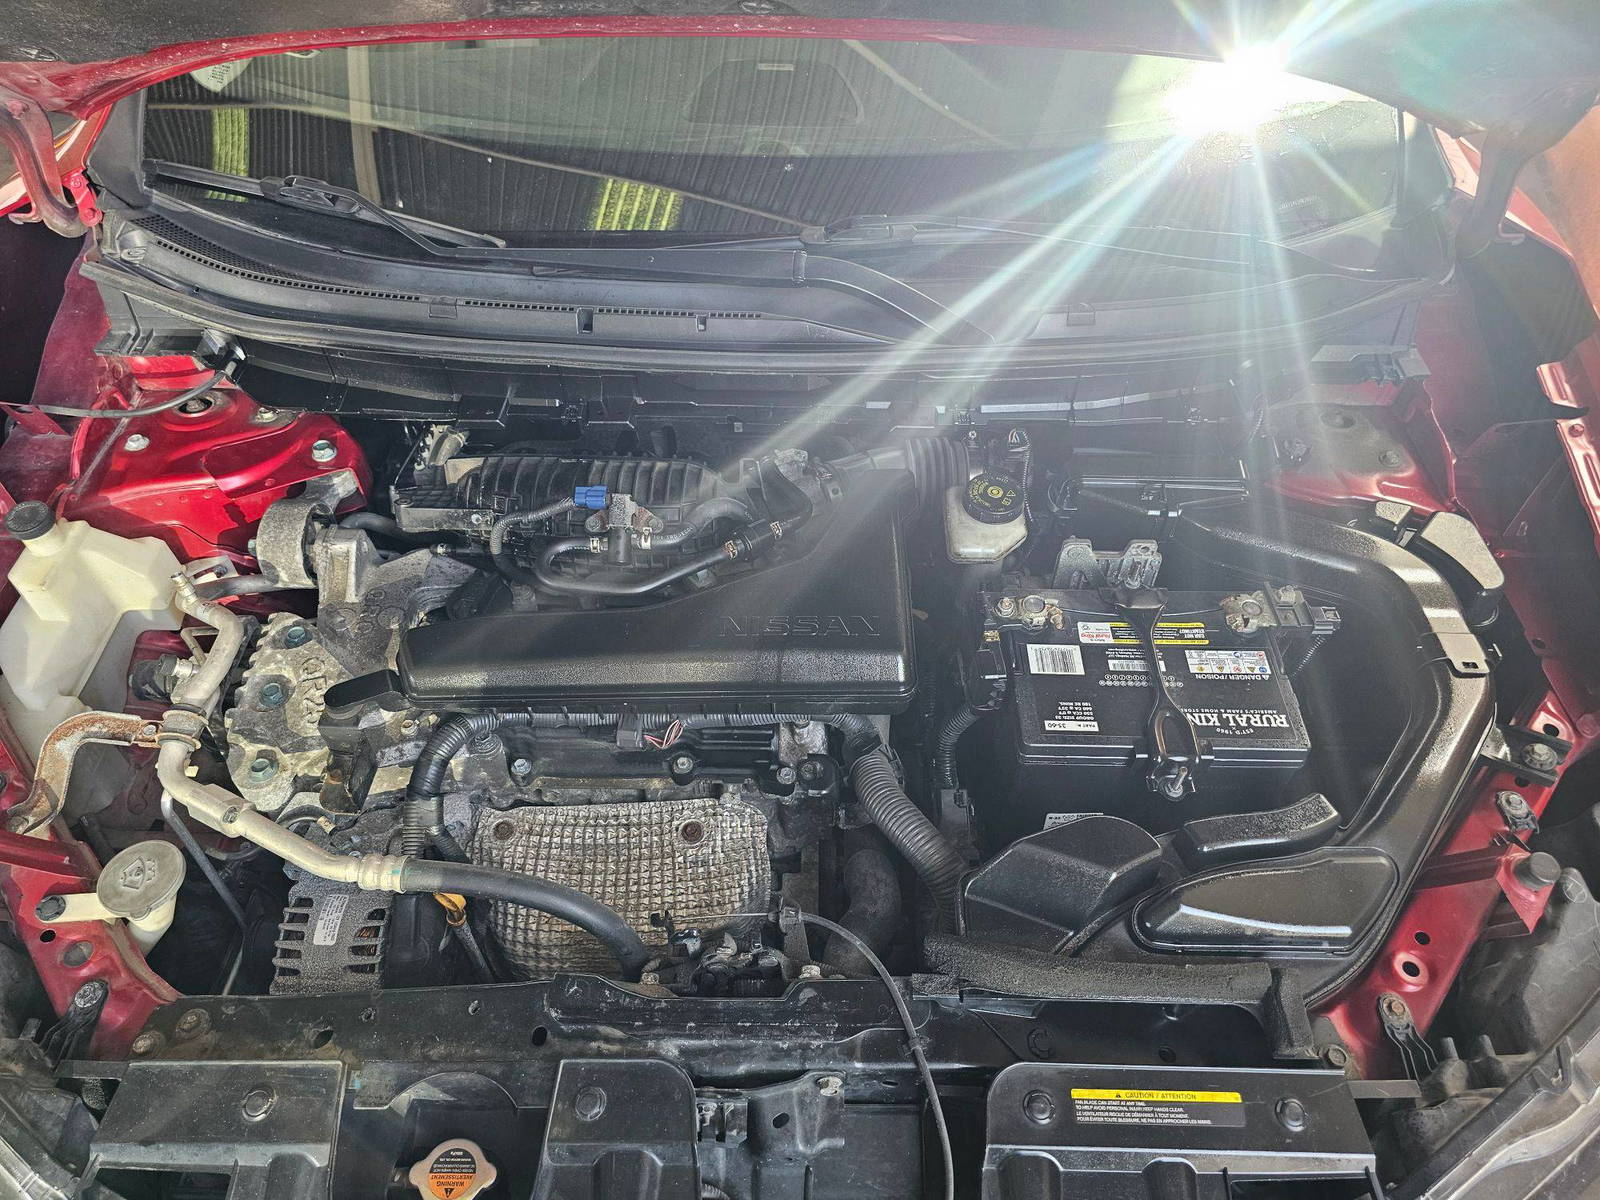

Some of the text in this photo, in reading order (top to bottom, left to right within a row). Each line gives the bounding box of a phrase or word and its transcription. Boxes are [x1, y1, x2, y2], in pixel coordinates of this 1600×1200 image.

[718, 616, 880, 636] NISSAN
[1185, 713, 1290, 727] RURAL KIN
